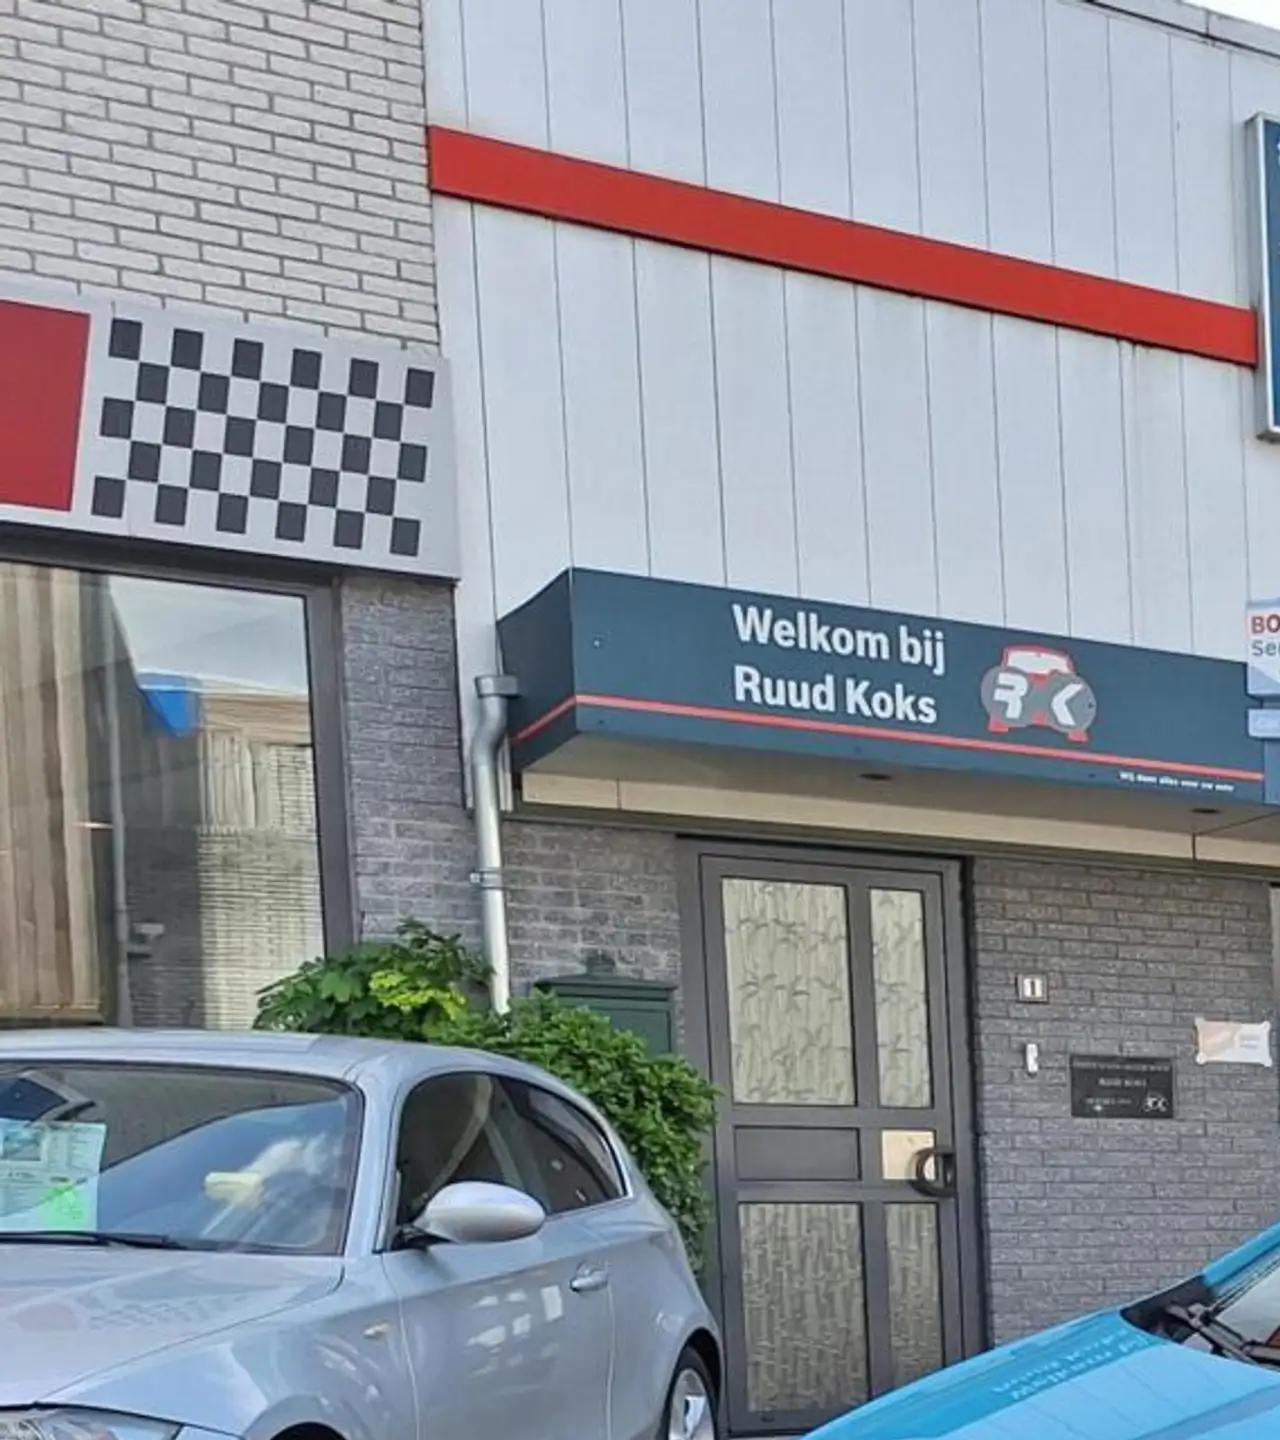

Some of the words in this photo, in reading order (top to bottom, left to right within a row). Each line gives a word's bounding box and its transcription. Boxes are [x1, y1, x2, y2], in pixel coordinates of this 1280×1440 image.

[732, 603, 890, 660] Welkom
[899, 624, 945, 676] bij
[733, 663, 836, 712] Ruud
[846, 677, 938, 724] Koks
